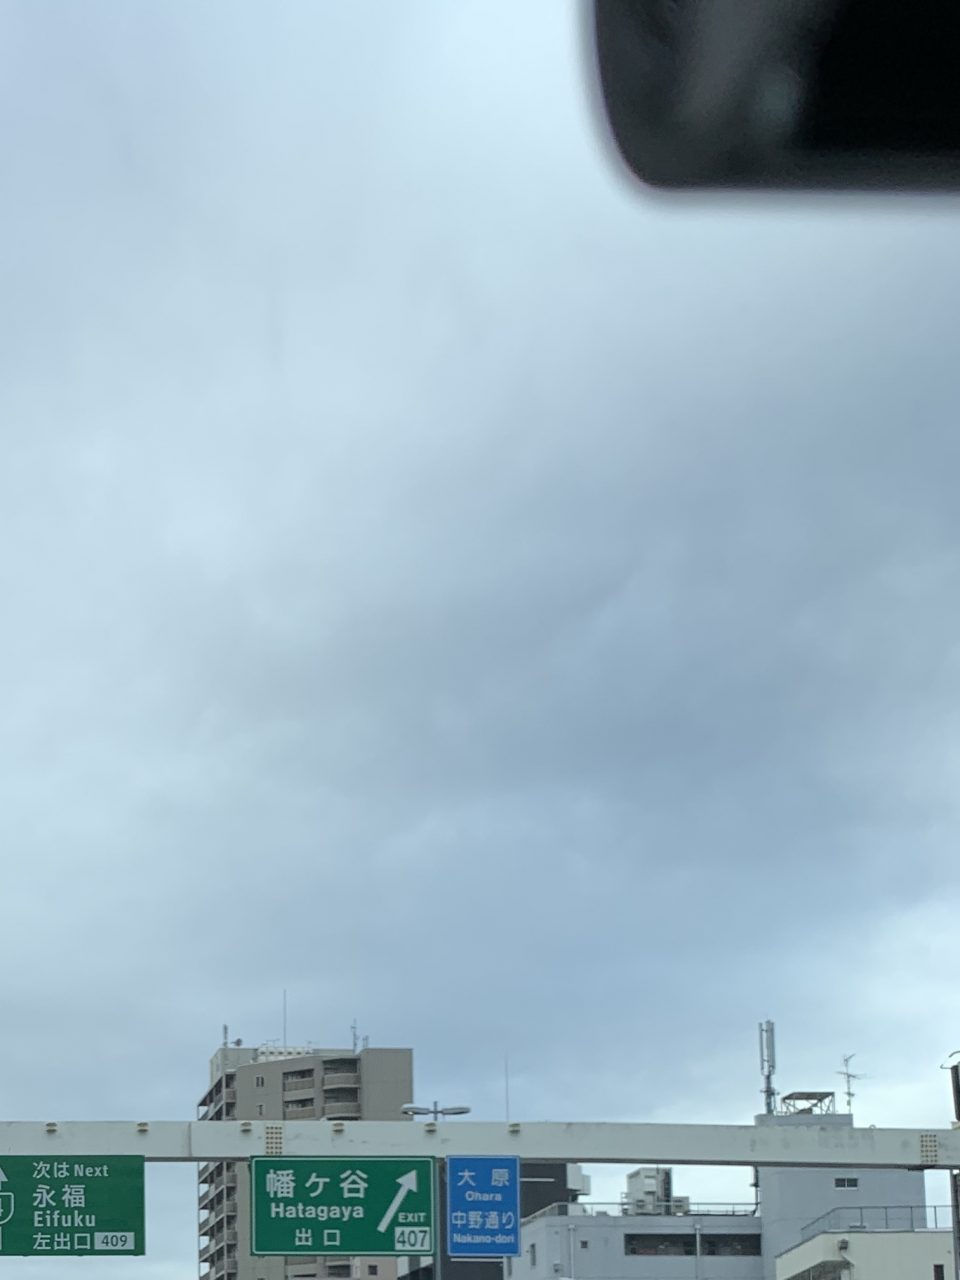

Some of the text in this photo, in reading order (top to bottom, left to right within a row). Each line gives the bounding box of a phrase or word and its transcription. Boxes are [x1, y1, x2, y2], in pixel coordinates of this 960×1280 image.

[32, 1161, 109, 1179] 次は Next
[457, 1168, 510, 1187] 大原
[32, 1184, 86, 1208] 永福
[465, 1190, 502, 1202] Ohara
[33, 1210, 96, 1227] Eifuku
[270, 1202, 365, 1221] Hatagaya
[398, 1212, 427, 1223] EXIT
[452, 1211, 515, 1229] 中野通り
[32, 1232, 128, 1250] 左出口 409
[295, 1228, 341, 1247] 出口
[396, 1230, 428, 1248] 407
[453, 1233, 515, 1244] Nakano-dori
